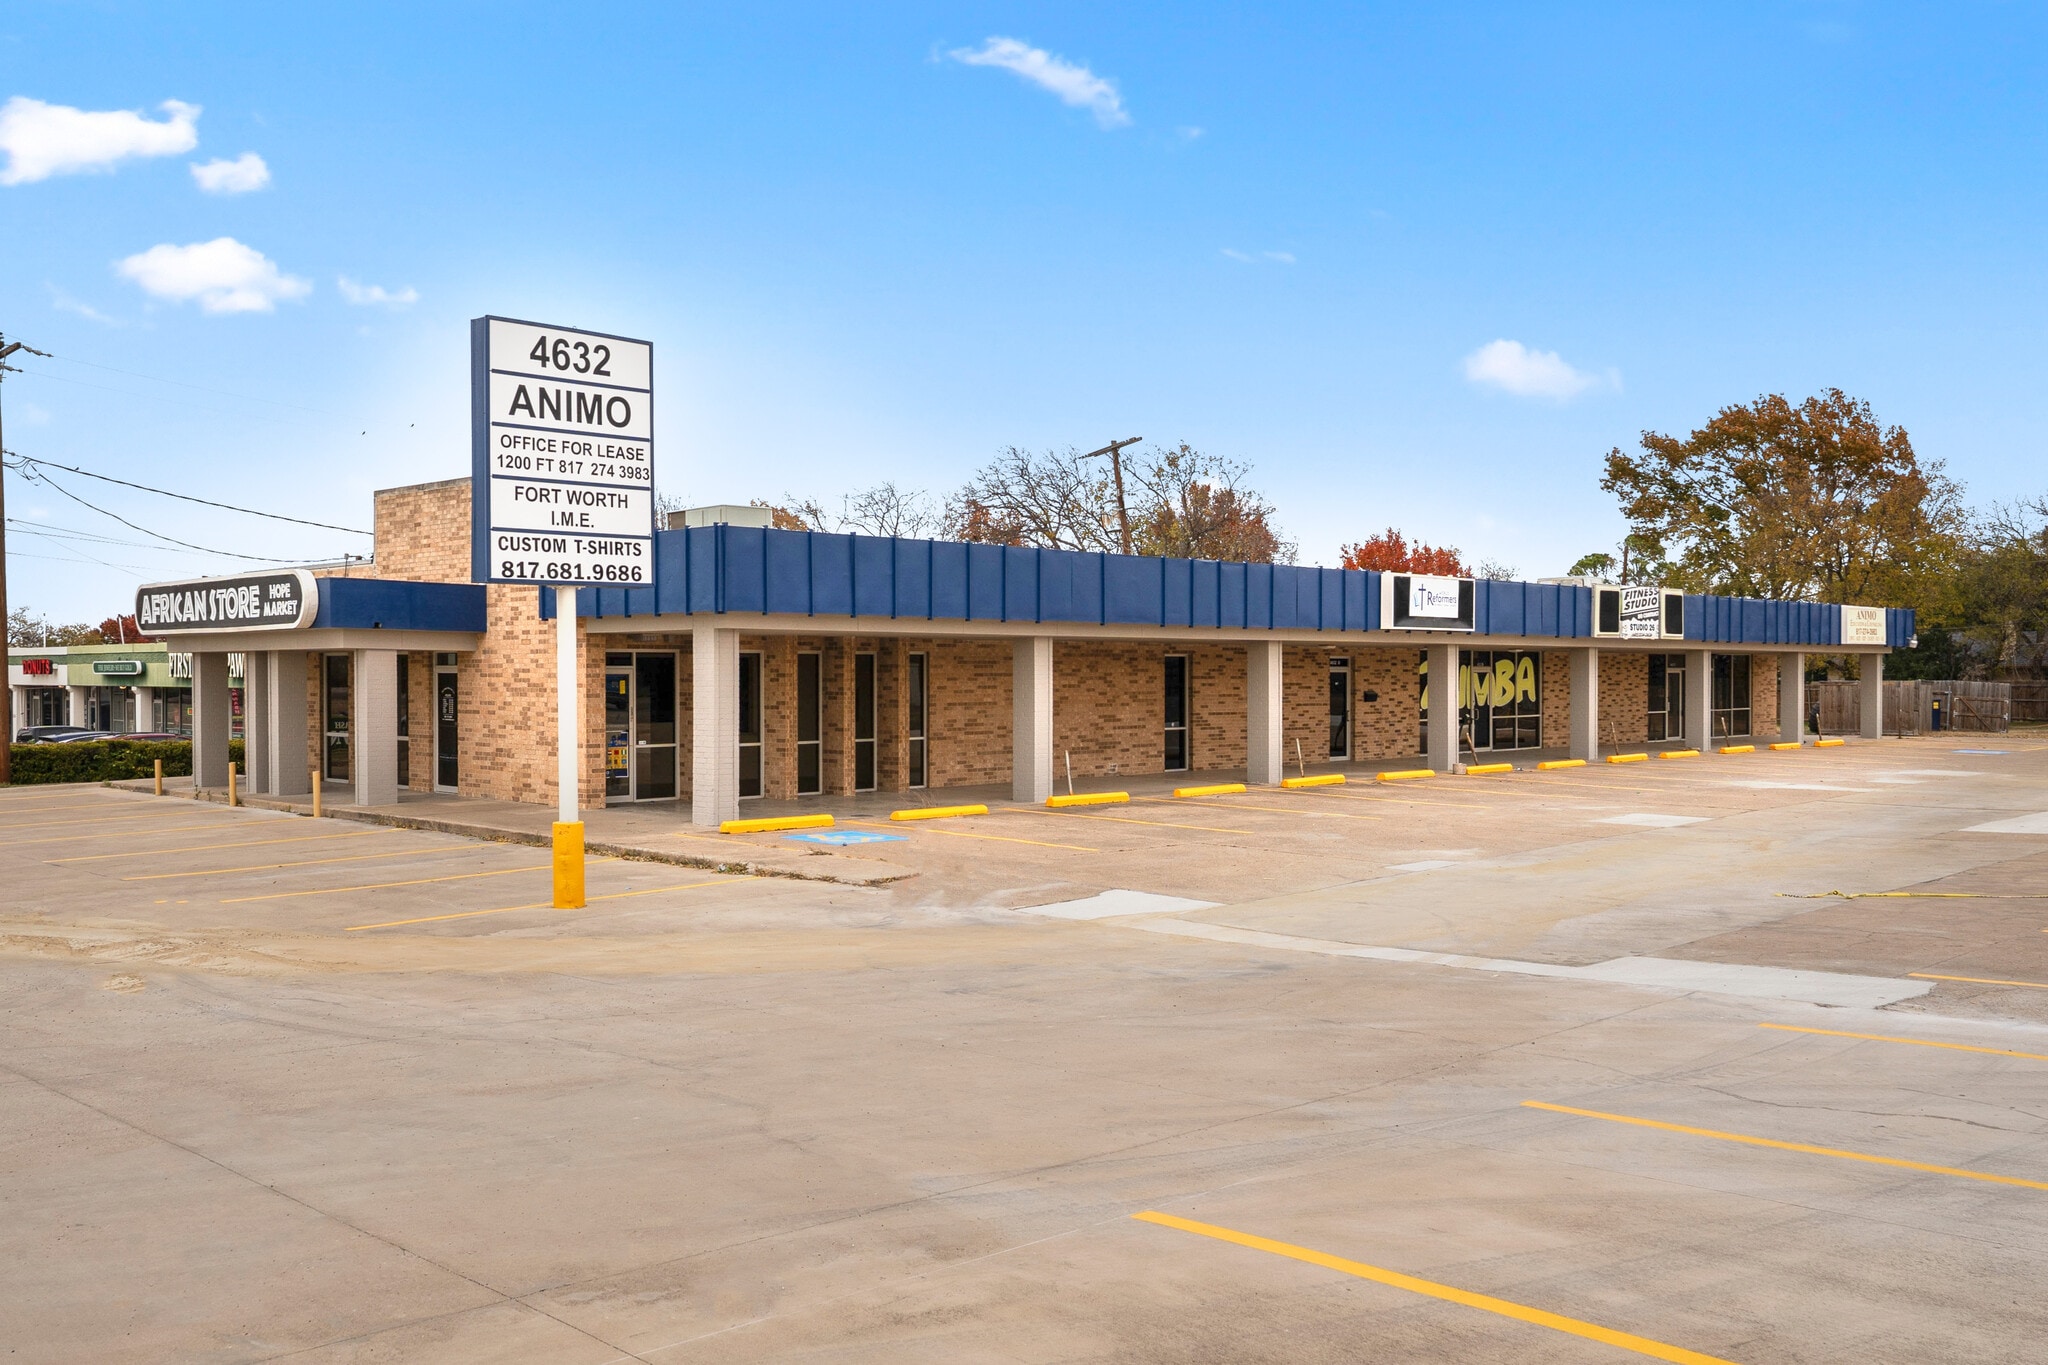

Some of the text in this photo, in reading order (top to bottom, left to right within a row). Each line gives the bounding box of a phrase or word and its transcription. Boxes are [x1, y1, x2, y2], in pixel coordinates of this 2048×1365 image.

[529, 335, 611, 377] 4632
[508, 384, 631, 428] ANIMO
[500, 434, 645, 462] OFFICE FOR LEASE
[496, 454, 650, 480] 1200 FT 817 274 3983
[514, 486, 629, 509] FORT WORTH
[551, 510, 595, 528] I.M.E.
[498, 535, 642, 557] CUSTOM T-SHIRTS
[501, 560, 643, 582] 817.681.9686
[269, 583, 291, 599] HOPE
[1624, 587, 1659, 601] FITNESS
[140, 585, 260, 625] AFRICAN STORE
[263, 600, 298, 617] MARKET
[1624, 597, 1658, 610] STUDIO
[1856, 610, 1877, 620] ANIMO
[1630, 623, 1649, 631] STUDIO
[22, 659, 51, 675] DONUTS
[168, 652, 193, 678] FIRST
